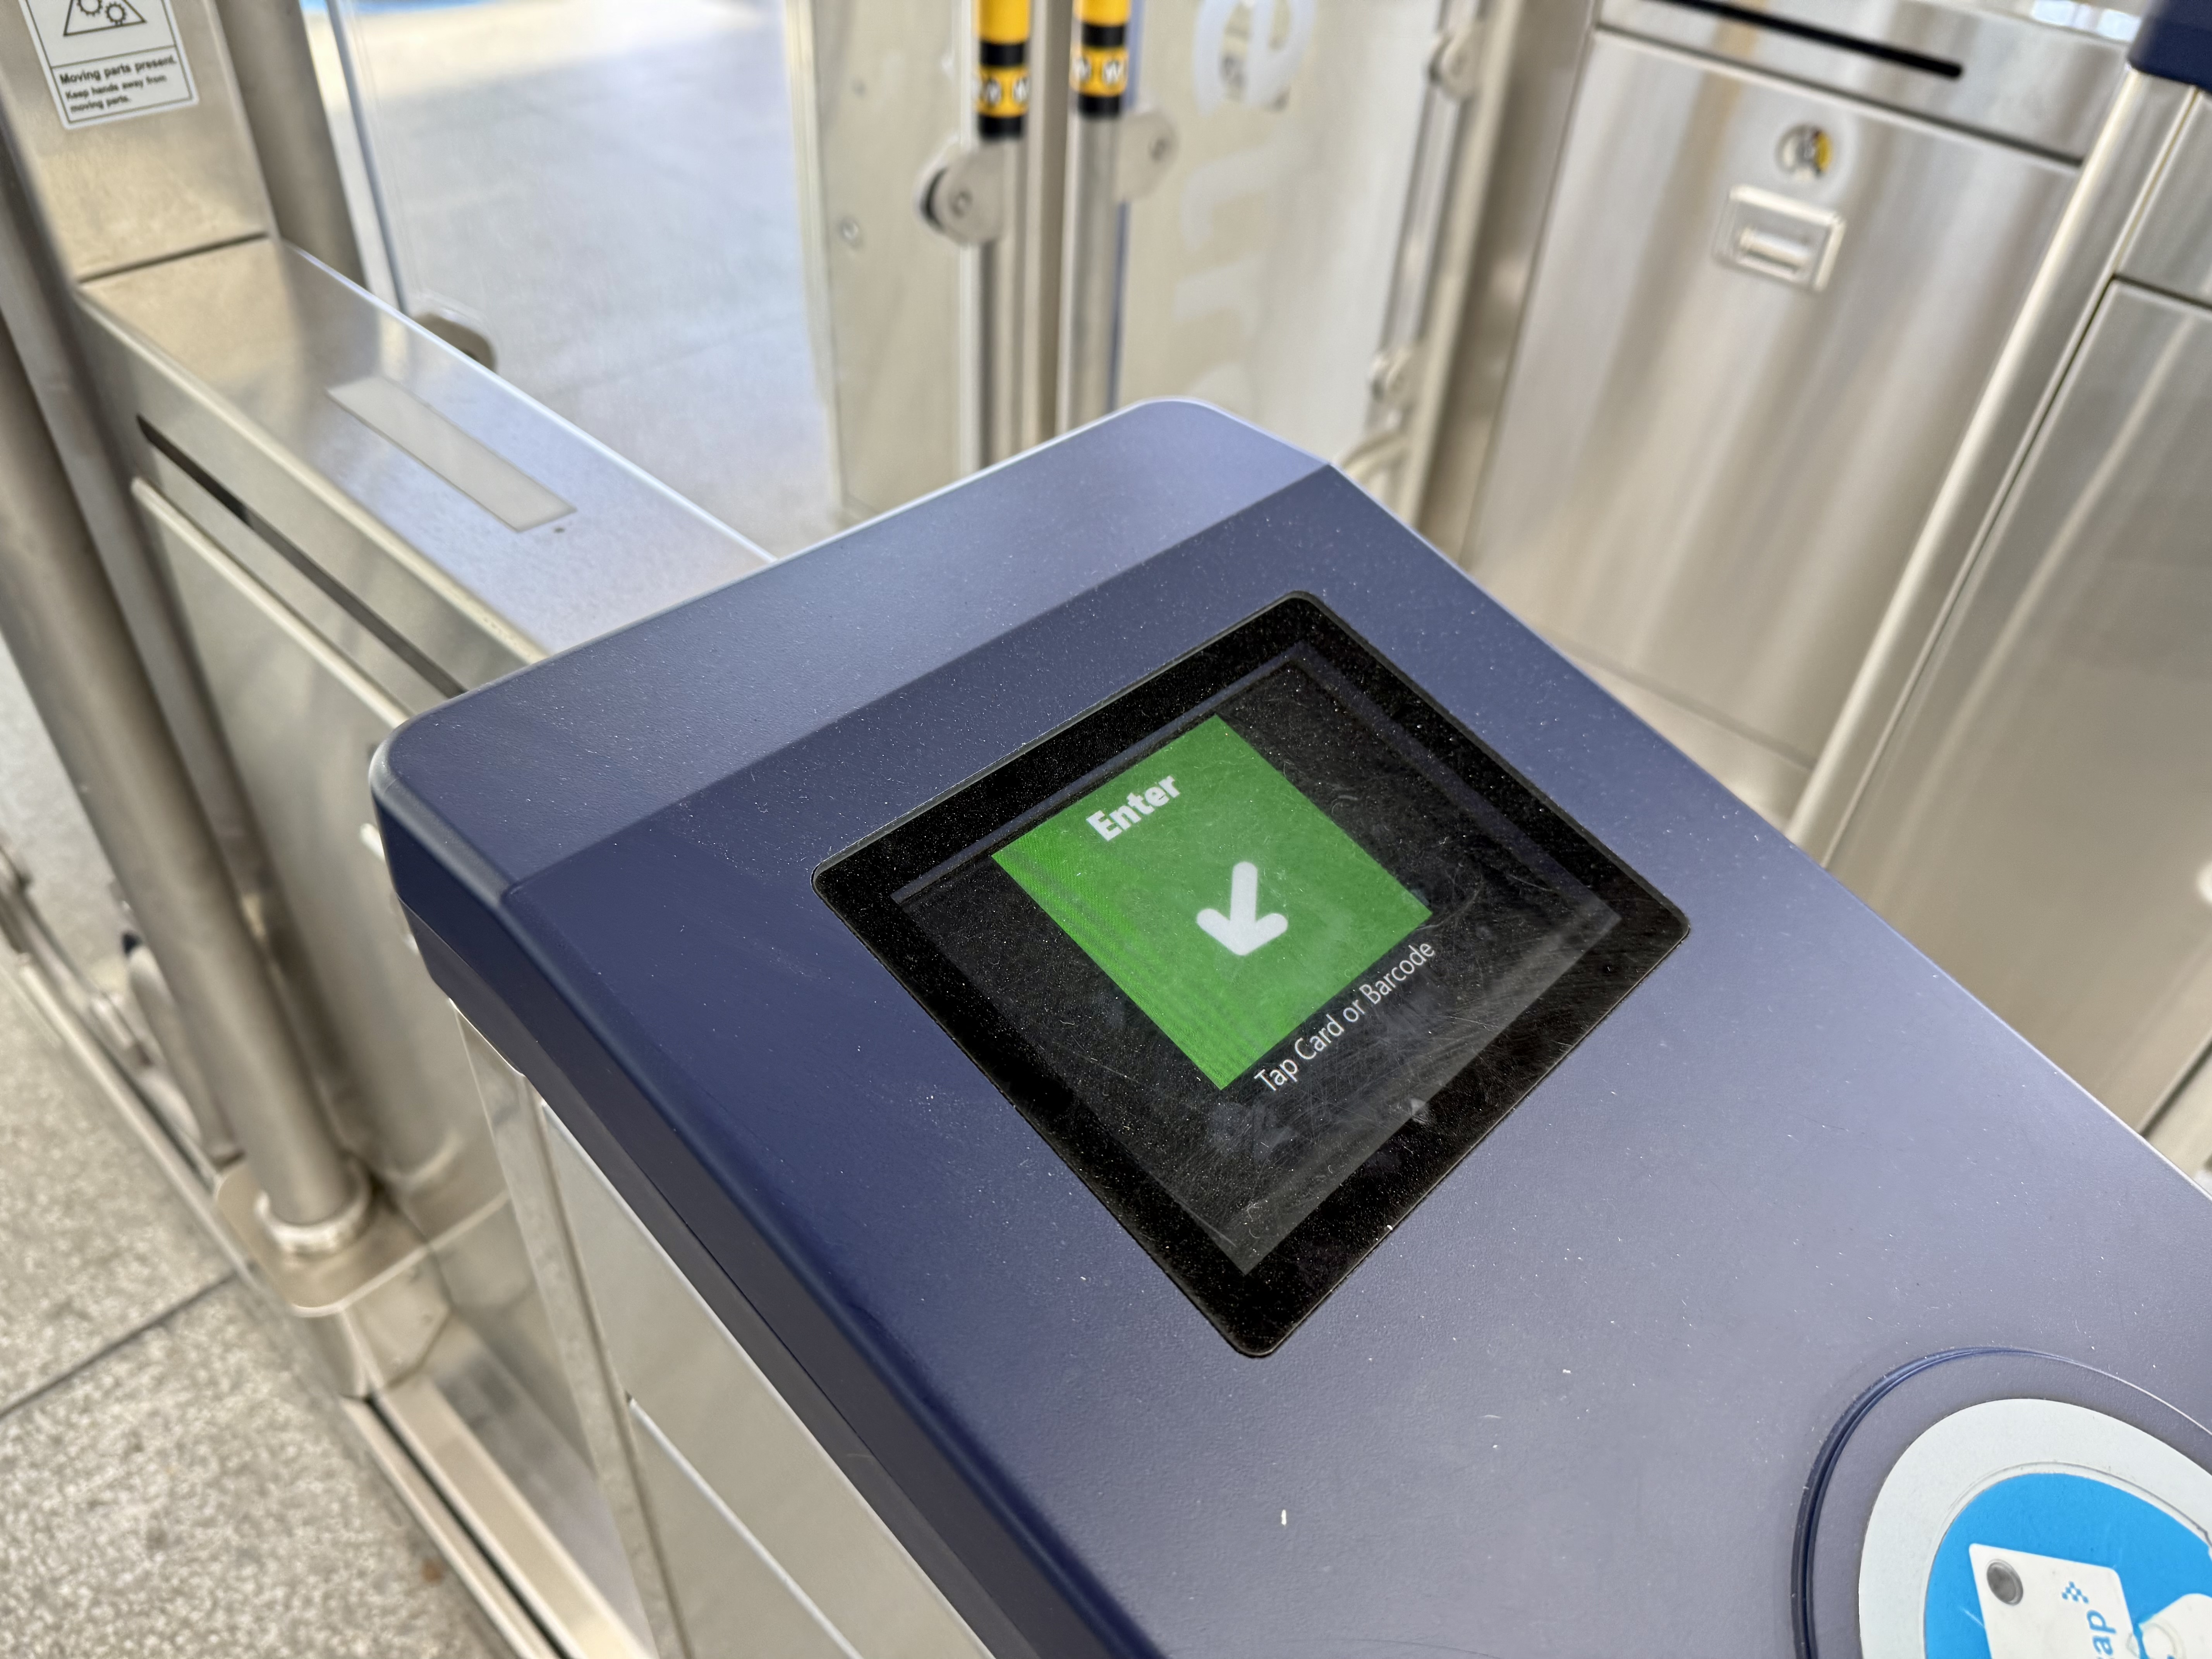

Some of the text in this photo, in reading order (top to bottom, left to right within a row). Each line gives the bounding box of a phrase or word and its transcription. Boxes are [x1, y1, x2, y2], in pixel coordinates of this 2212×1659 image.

[59, 69, 101, 85] Moving
[104, 64, 131, 79] parts
[65, 74, 167, 101] Keep hands away from
[70, 100, 103, 112] moving
[1086, 775, 1180, 842] Enter
[1254, 942, 1435, 1091] Tap Card or Barcode
[2087, 1610, 2116, 1659] ap
